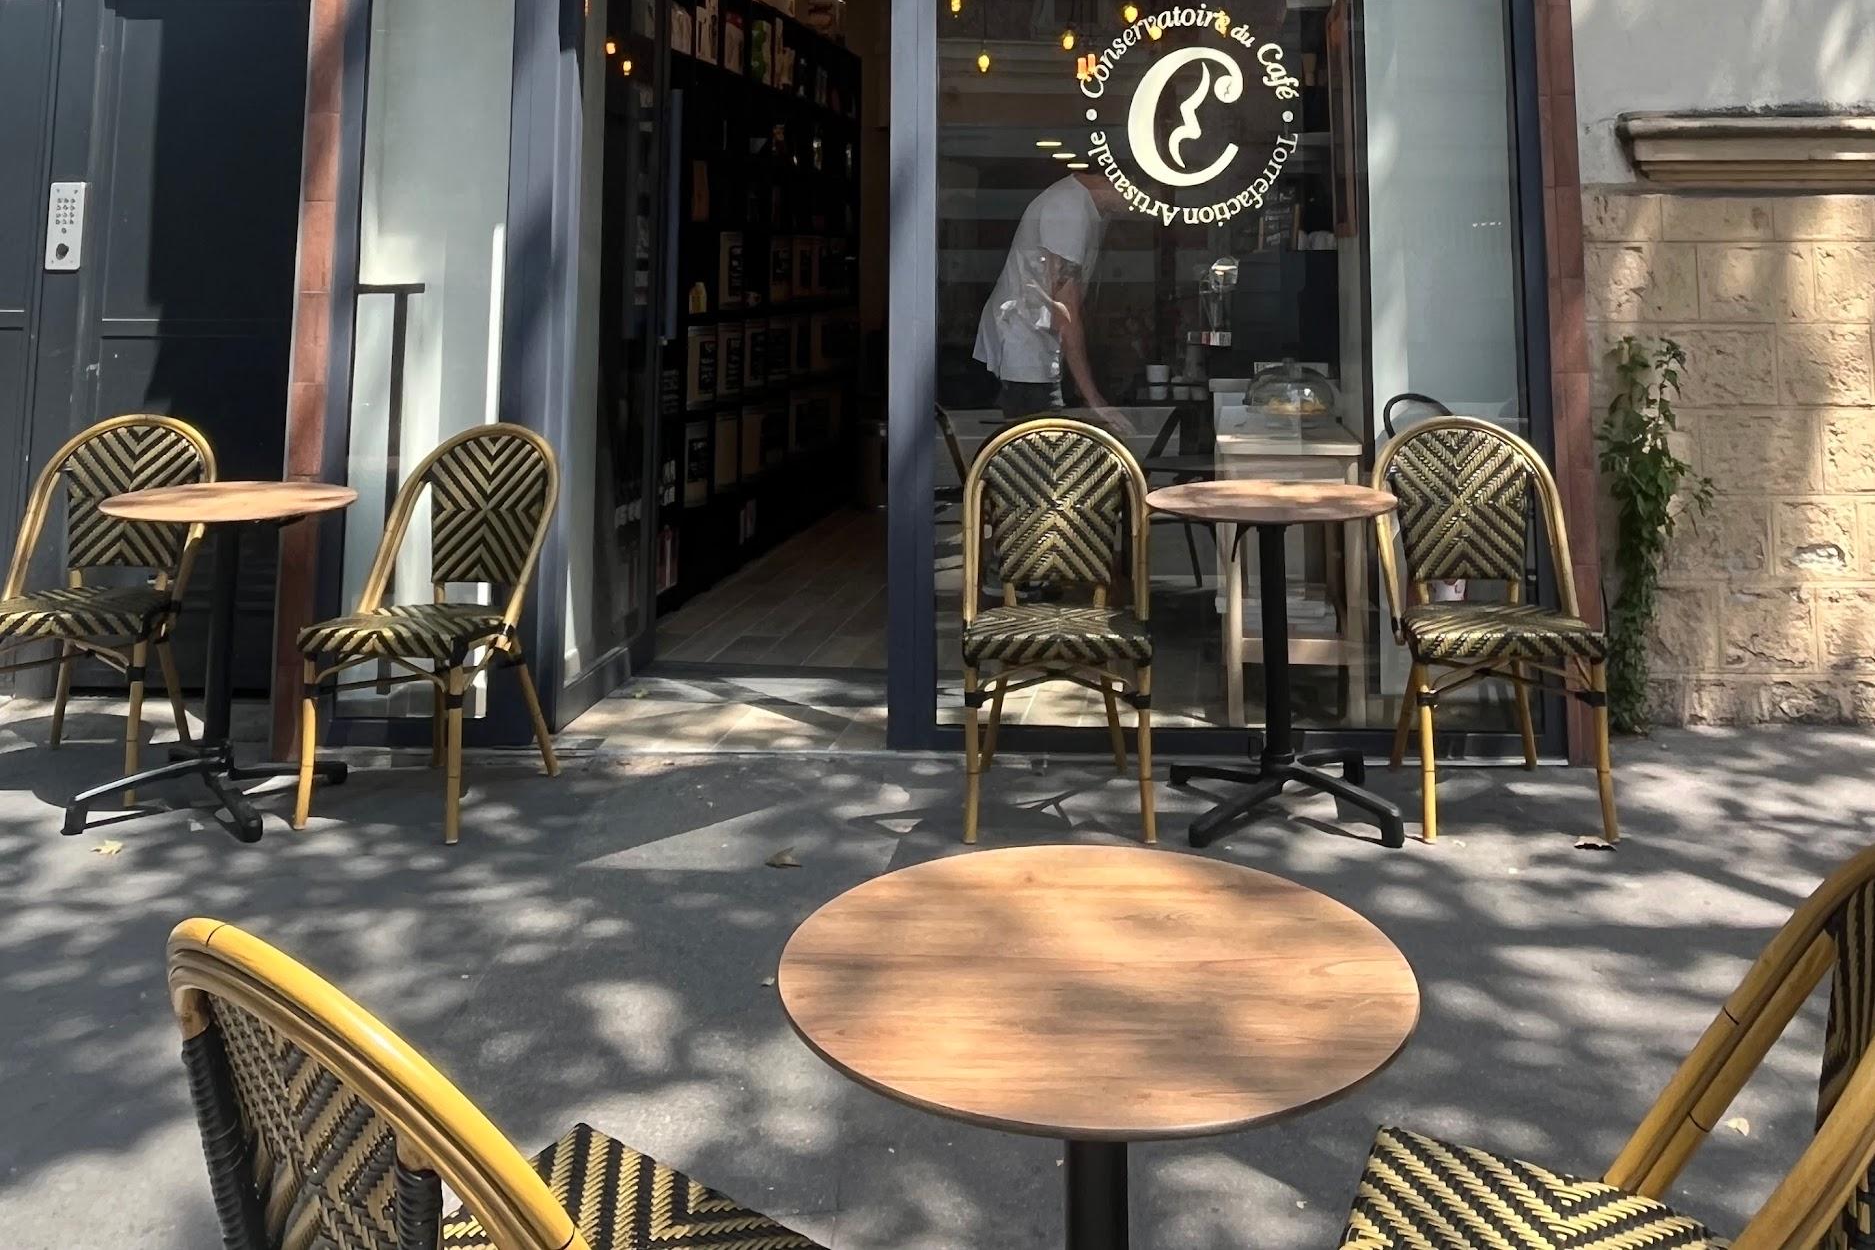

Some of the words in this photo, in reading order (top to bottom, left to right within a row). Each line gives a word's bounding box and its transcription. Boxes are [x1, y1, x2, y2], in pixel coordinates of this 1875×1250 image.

[1080, 4, 1230, 98] Conservatoire
[1230, 24, 1256, 48] du
[1256, 43, 1300, 99] Café
[1088, 131, 1181, 226] Artisanale
[1183, 133, 1298, 227] Torrefaction
